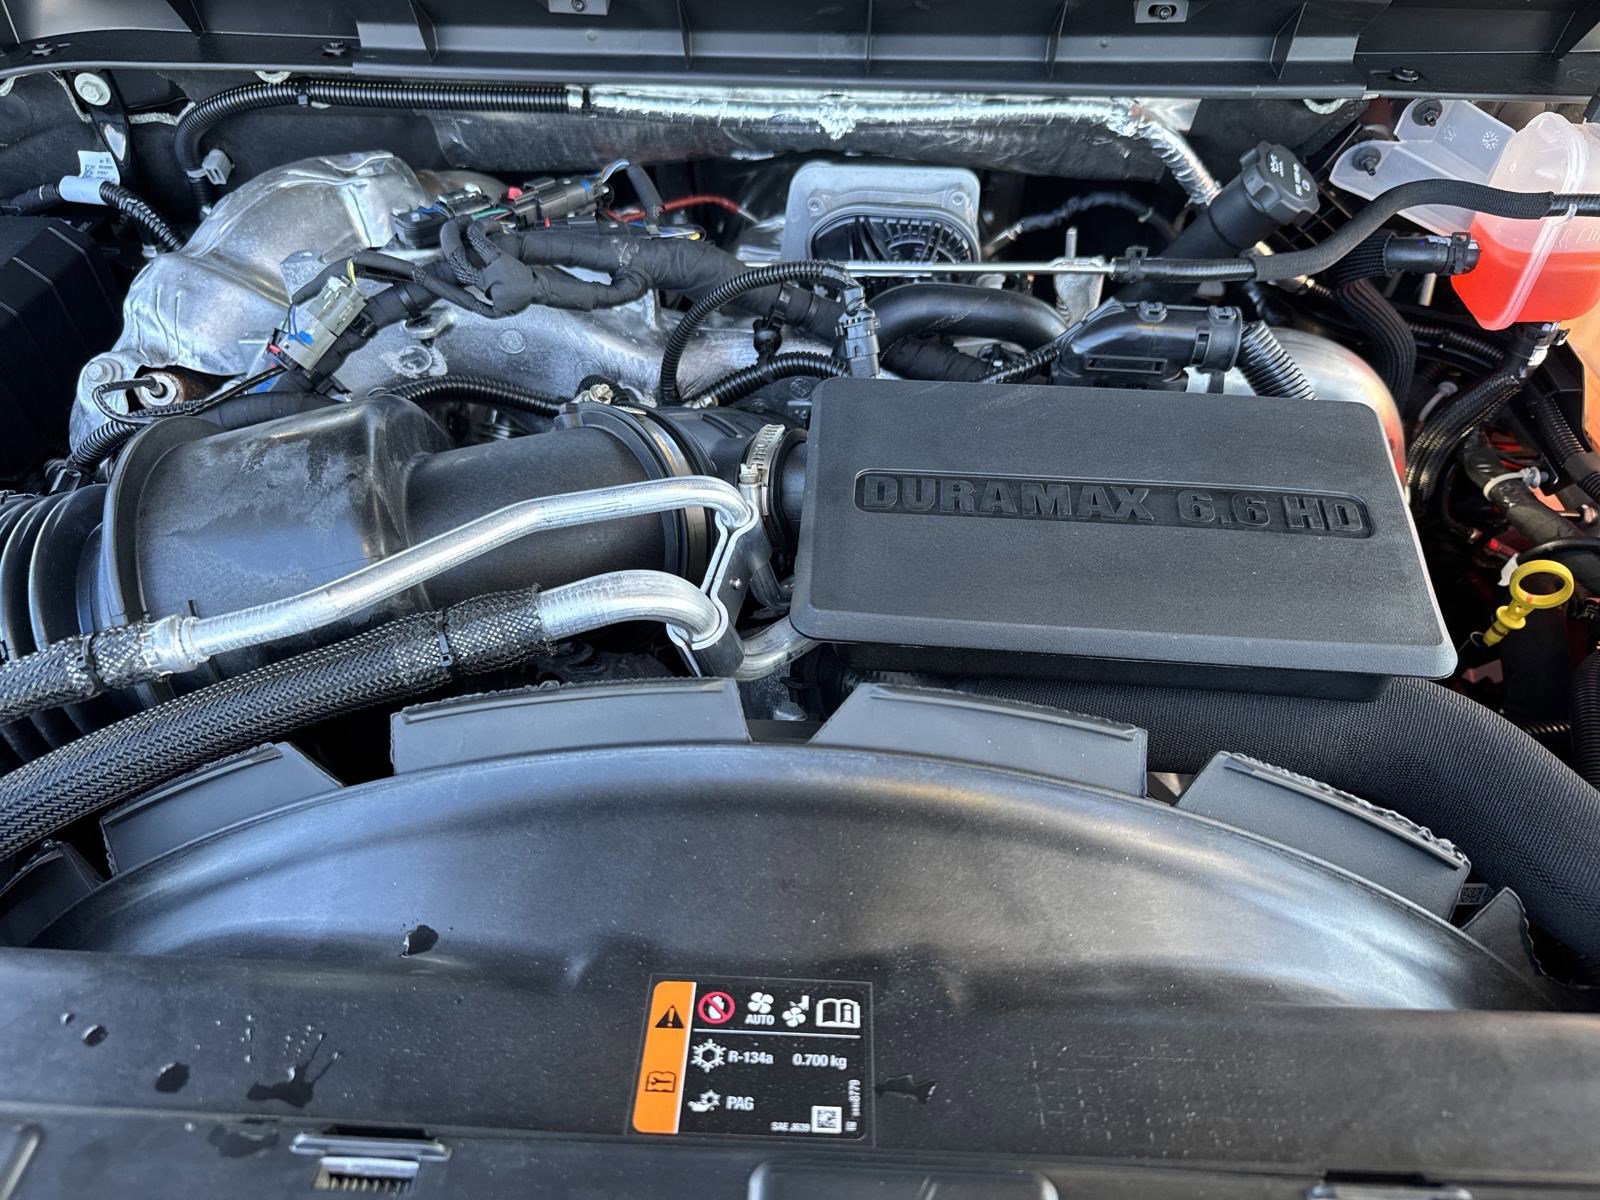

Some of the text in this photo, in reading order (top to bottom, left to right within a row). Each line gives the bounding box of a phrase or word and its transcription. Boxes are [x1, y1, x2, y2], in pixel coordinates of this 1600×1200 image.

[863, 476, 1362, 532] DURAMAX 6.6 HD
[744, 1014, 775, 1025] AUTO
[727, 1050, 848, 1070] R-134a 0.700 kg
[725, 1096, 754, 1111] PAG
